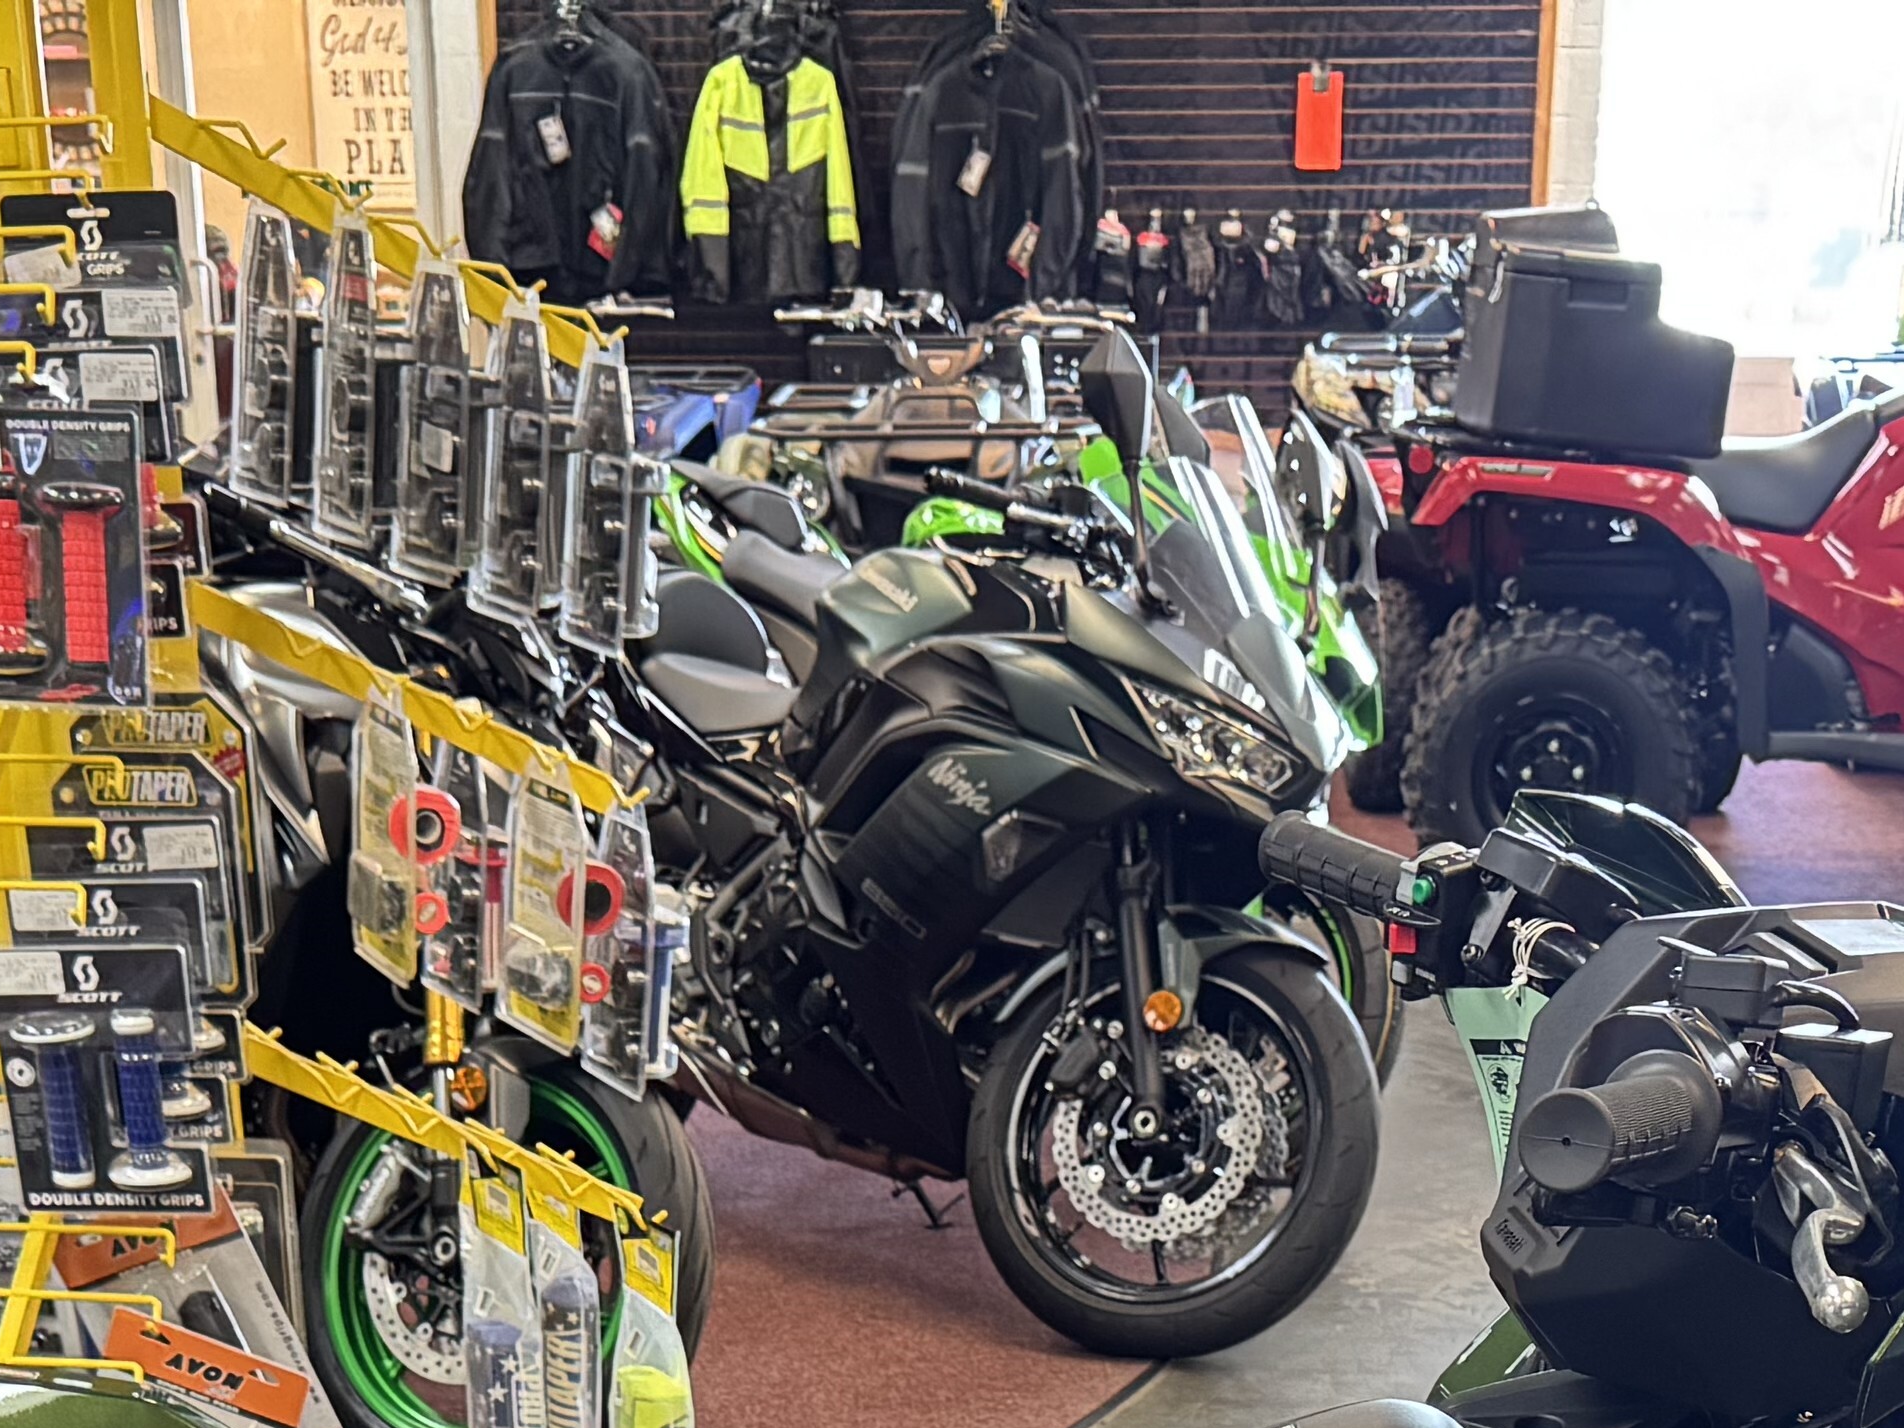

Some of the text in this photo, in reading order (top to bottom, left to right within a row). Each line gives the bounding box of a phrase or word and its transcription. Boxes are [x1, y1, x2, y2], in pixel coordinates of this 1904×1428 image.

[928, 756, 992, 817] Ninja
[28, 1192, 205, 1207] DOUBLE DENSITY GRIPS
[165, 1353, 245, 1390] AVON
